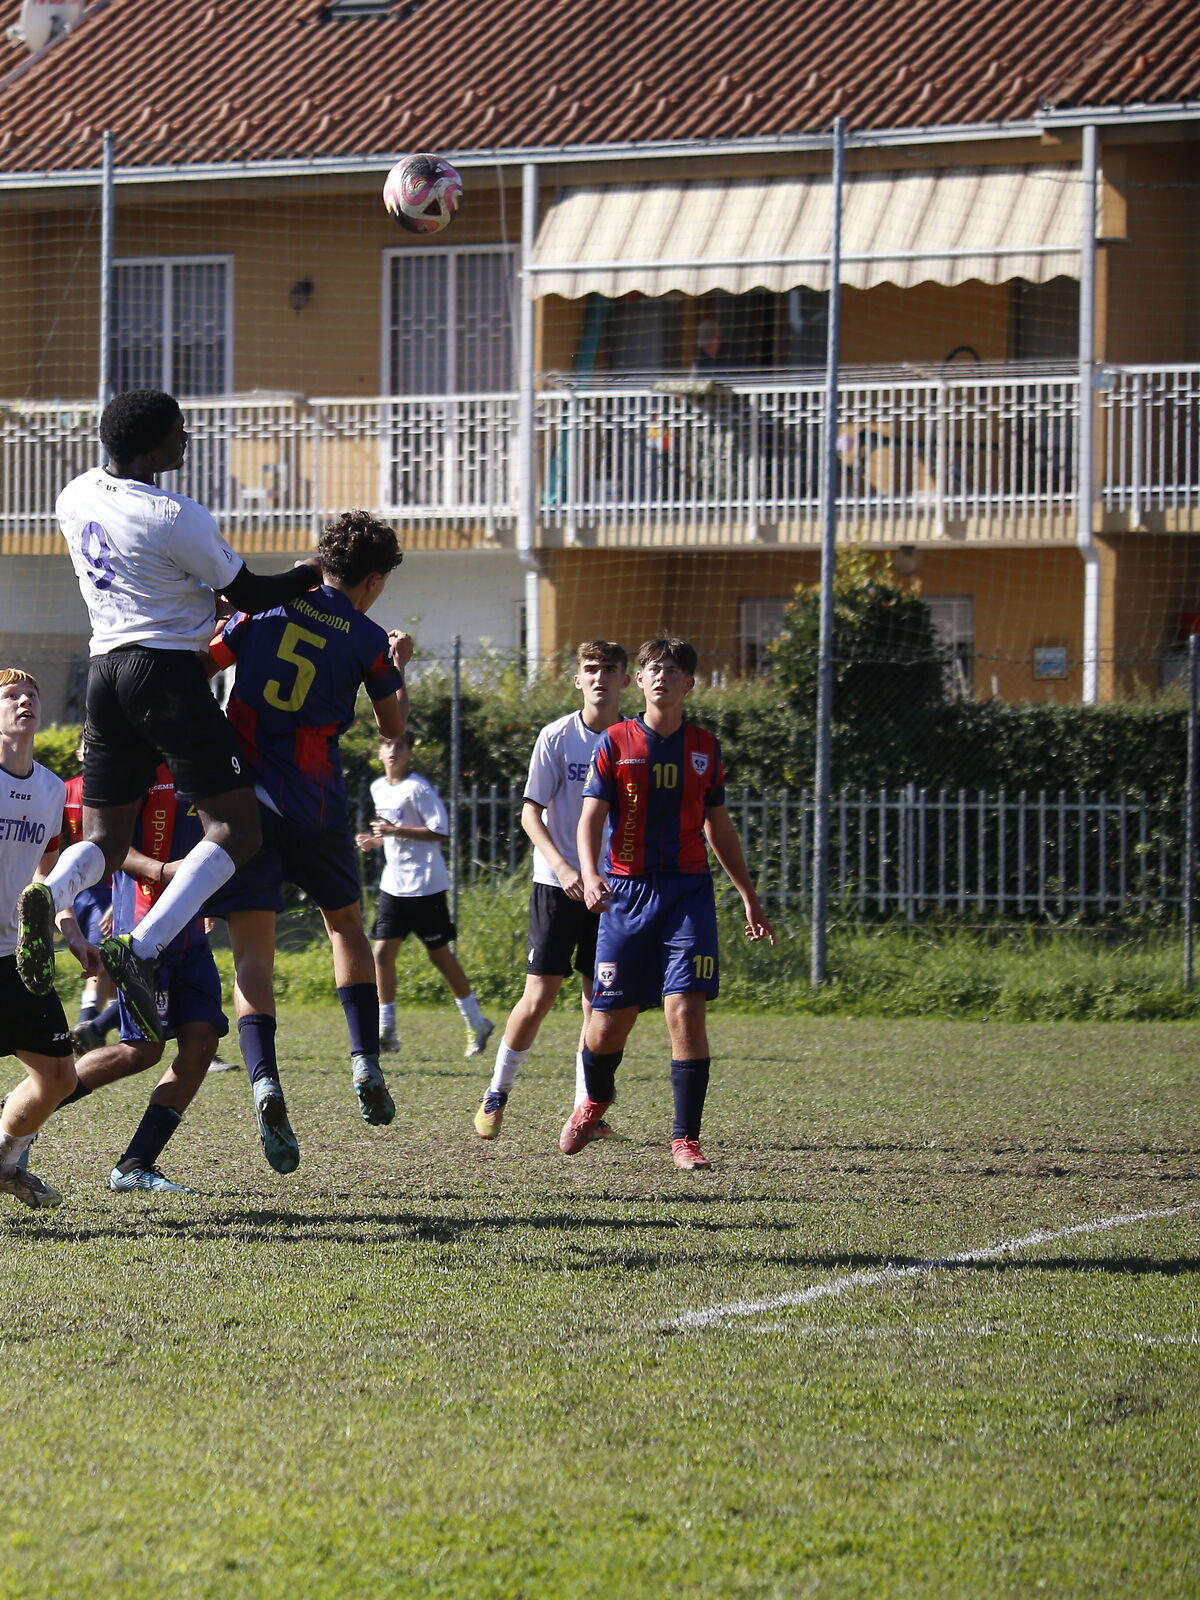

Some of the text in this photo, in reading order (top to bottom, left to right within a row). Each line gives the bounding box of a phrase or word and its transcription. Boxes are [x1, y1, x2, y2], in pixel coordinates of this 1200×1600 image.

[96, 479, 118, 493] Zus
[81, 521, 116, 590] 9
[289, 598, 351, 634] ARRACUDA
[263, 622, 327, 712] 5
[231, 756, 241, 774] 9
[567, 763, 591, 782] SE
[653, 763, 678, 789] 10
[9, 790, 32, 801] Zeus
[528, 949, 535, 964] 4
[693, 955, 715, 979] 10
[52, 1032, 71, 1042] Zeu
